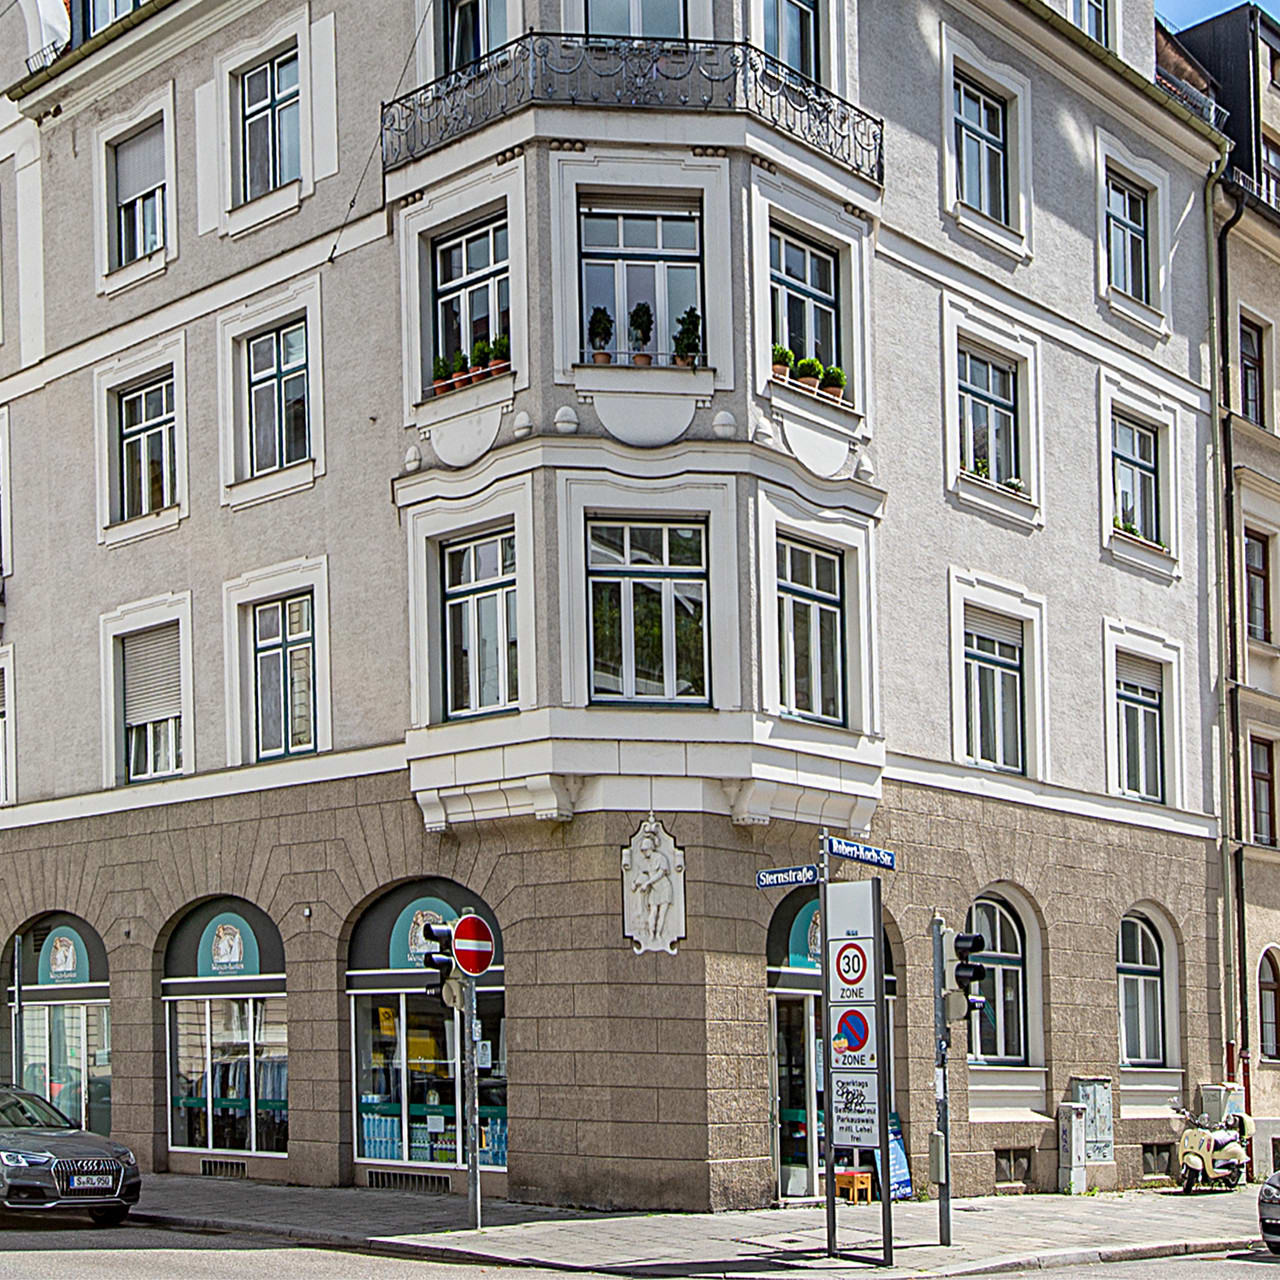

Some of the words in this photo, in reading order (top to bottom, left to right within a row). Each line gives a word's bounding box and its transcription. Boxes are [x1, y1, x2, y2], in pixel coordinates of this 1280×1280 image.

[759, 867, 814, 885] Sternstraße
[842, 954, 861, 974] 30
[840, 987, 865, 999] ZONE
[841, 1054, 867, 1066] ZONE
[76, 1176, 82, 1186] S
[96, 1176, 110, 1186] 950
